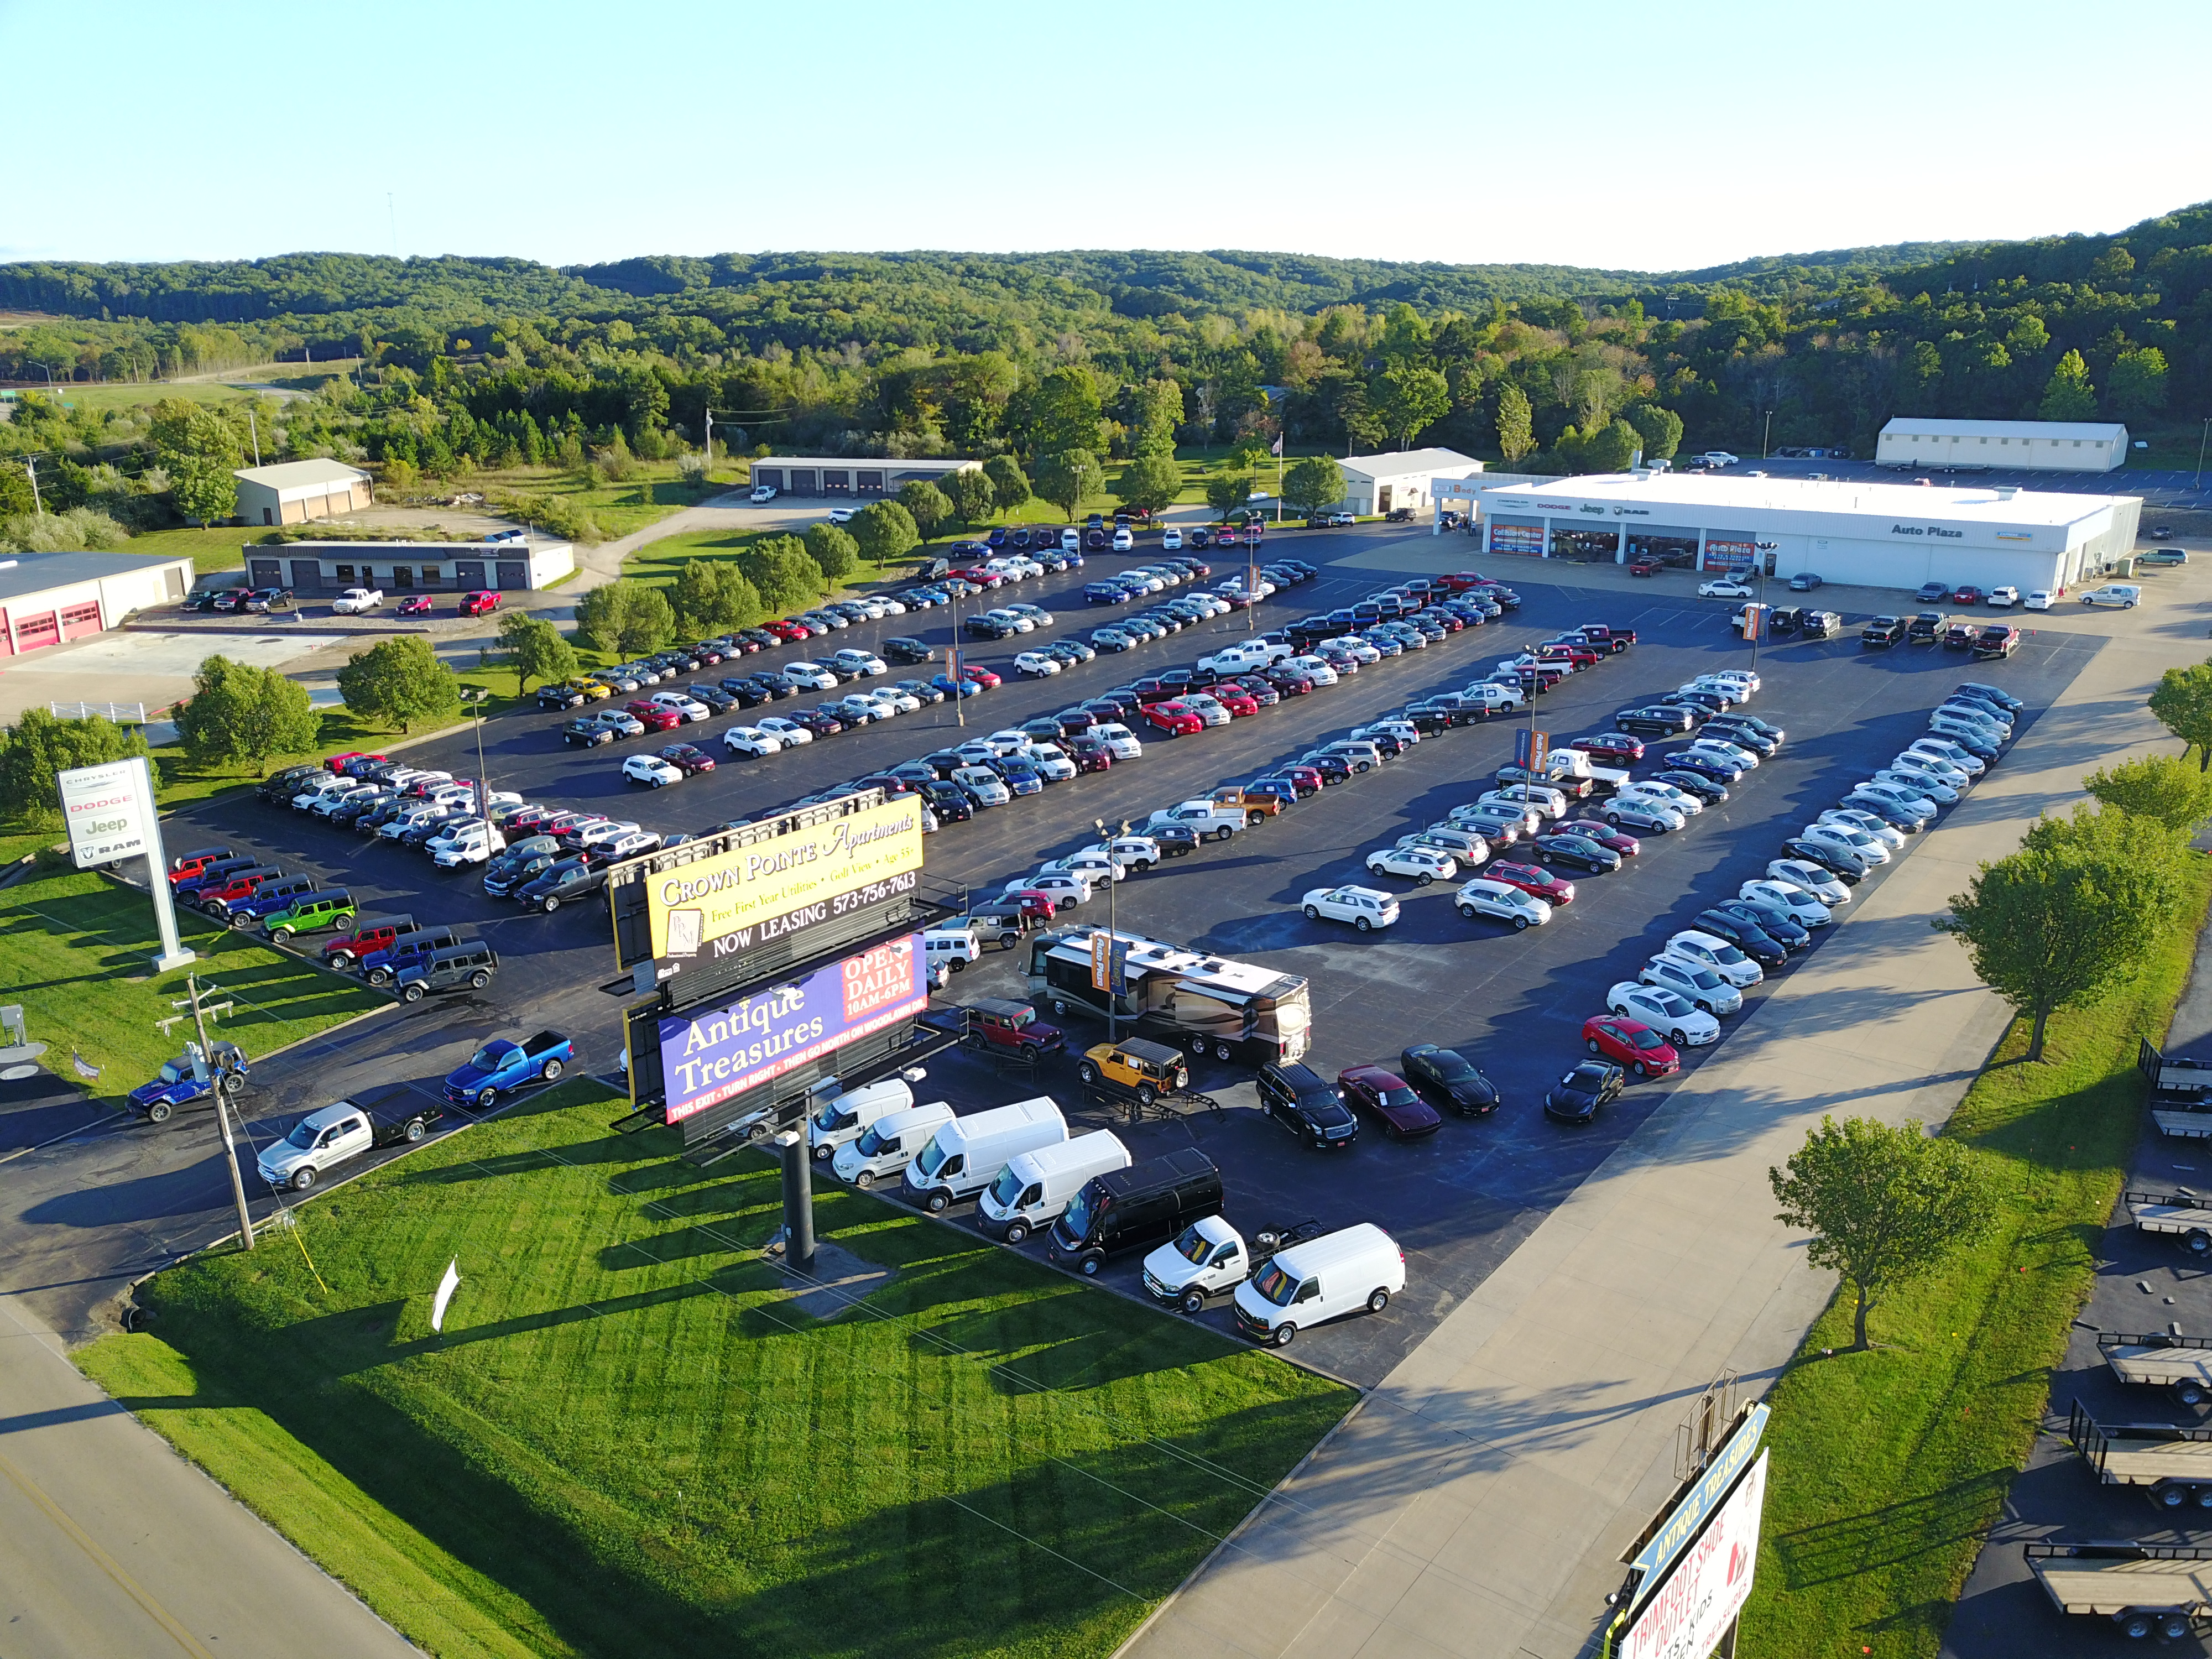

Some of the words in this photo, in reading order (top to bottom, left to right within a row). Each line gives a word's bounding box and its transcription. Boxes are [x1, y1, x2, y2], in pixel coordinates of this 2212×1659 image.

[1454, 484, 1476, 495] Body
[1579, 503, 1604, 515] Jeep
[1494, 528, 1520, 537] Collision
[1709, 544, 1729, 552] Auto
[1730, 545, 1751, 554] Plaza
[1891, 524, 1923, 535] Auto
[1927, 526, 1963, 538] Plaza
[66, 769, 126, 785] CHRYSLER
[1534, 750, 1543, 770] Plaza
[70, 795, 133, 812] DODGE
[85, 818, 127, 834] Jeep
[98, 839, 141, 854] RAM
[660, 865, 739, 907] CROWN
[745, 842, 817, 881] POINTE
[822, 813, 914, 859] Apartments
[712, 910, 732, 922] Free
[735, 899, 756, 914] First
[759, 893, 779, 906] Year
[781, 879, 817, 898] Utilities
[830, 867, 849, 881] Golf
[852, 861, 872, 874] View
[884, 854, 898, 865] Age
[713, 927, 753, 958] NOW
[760, 902, 826, 941] LEASING
[833, 871, 916, 914] 573-756-7613
[1096, 937, 1104, 961] Auto
[1111, 949, 1124, 986] Jeep
[847, 959, 909, 1000] DAILY
[1096, 962, 1104, 987] Plaza
[847, 978, 910, 1016] 10AM-6PM
[683, 988, 805, 1056] Antique
[671, 1101, 695, 1119] THIS
[695, 1091, 716, 1110] EXIT
[722, 1077, 747, 1097] TURN
[748, 1065, 776, 1085] RIGHT
[783, 1052, 806, 1070] THEN
[807, 1045, 821, 1058] GO
[821, 1031, 850, 1051] NORTH
[851, 1026, 864, 1039] ON
[864, 1004, 911, 1032] WOODLAWN
[912, 998, 925, 1010] DR.
[675, 1016, 823, 1094] Treasures
[1655, 1491, 1701, 1569] ANTIQUE
[1704, 1418, 1757, 1505] TREASURES
[1633, 1552, 1694, 1659] TRIMFOOT
[1696, 1510, 1726, 1573] SHOE
[1655, 1573, 1701, 1658] OUTLET
[1689, 1589, 1713, 1635] KIDS
[1701, 1577, 1747, 1655] TREASURES
